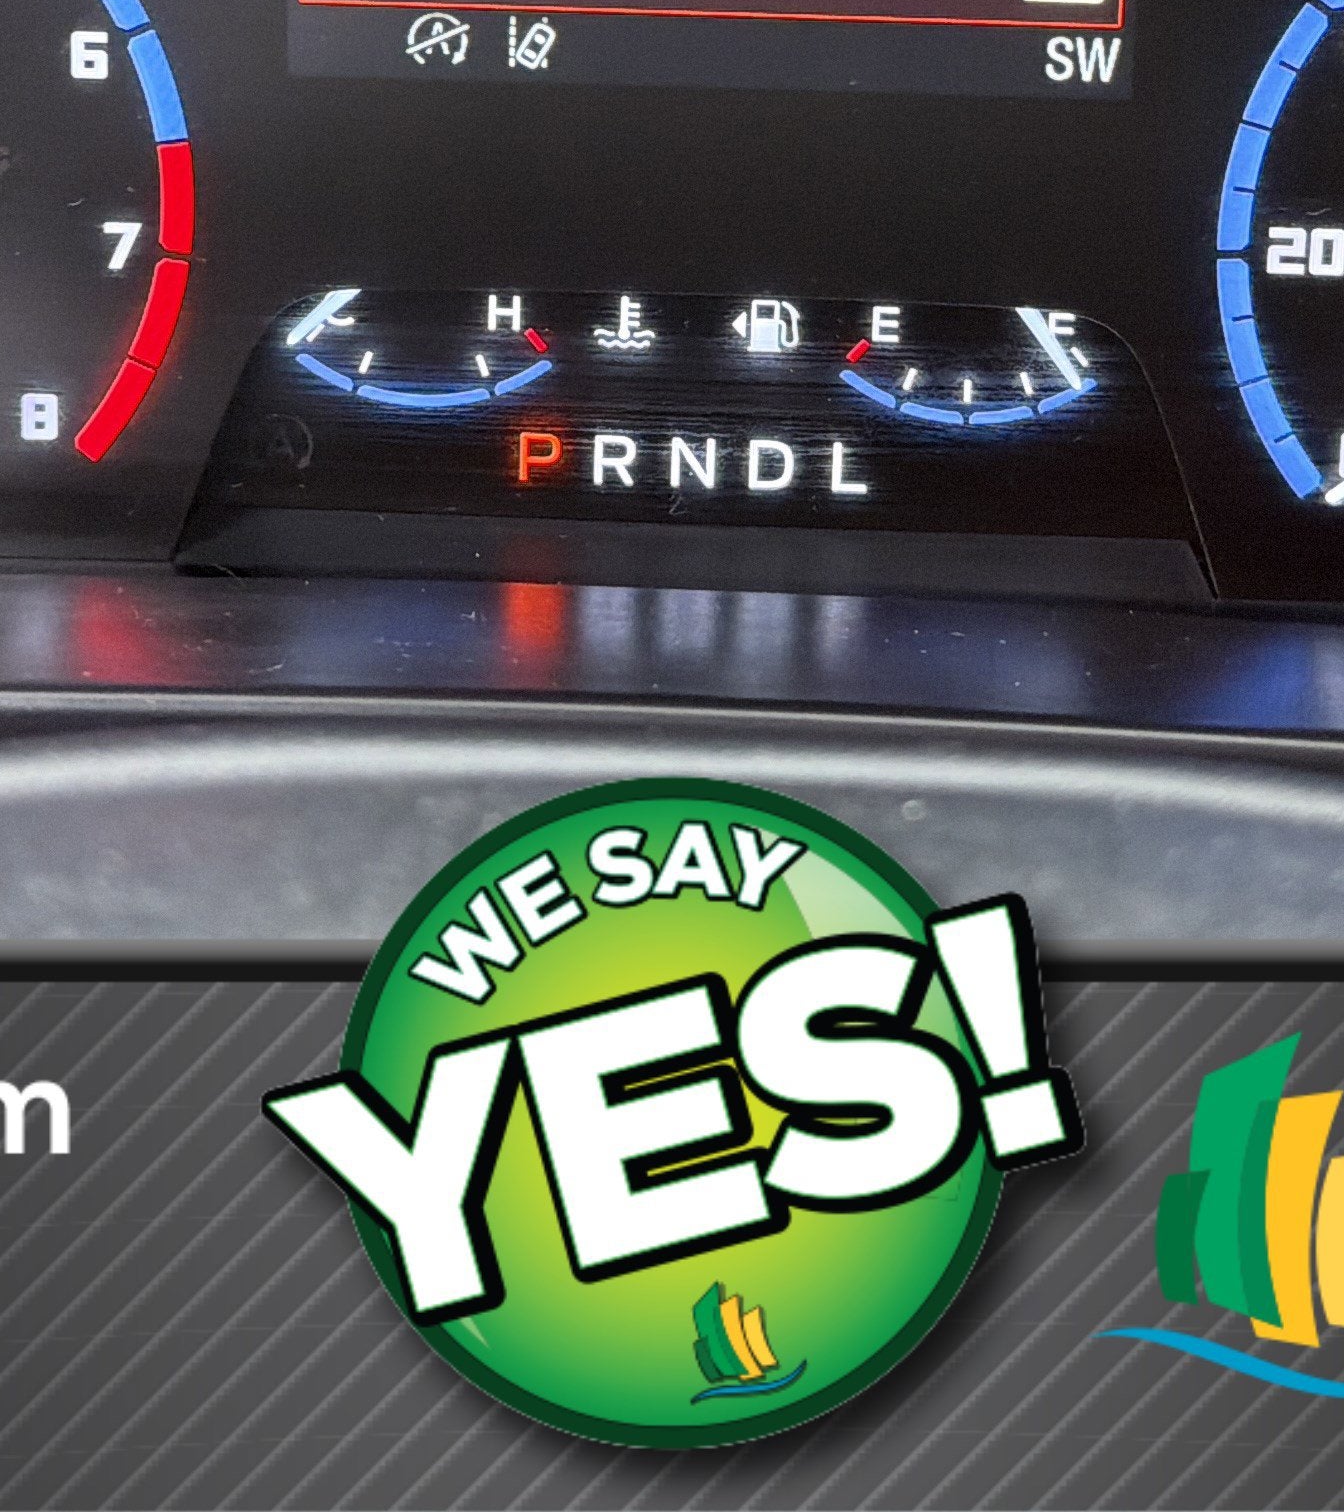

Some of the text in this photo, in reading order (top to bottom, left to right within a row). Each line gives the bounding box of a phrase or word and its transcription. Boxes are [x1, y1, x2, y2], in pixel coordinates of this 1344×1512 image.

[70, 31, 108, 79] 6
[1046, 37, 1121, 83] SW
[102, 222, 142, 271] 7
[488, 295, 521, 332] H
[871, 307, 901, 344] E
[18, 389, 62, 441] 8
[519, 432, 867, 494] P R N D L
